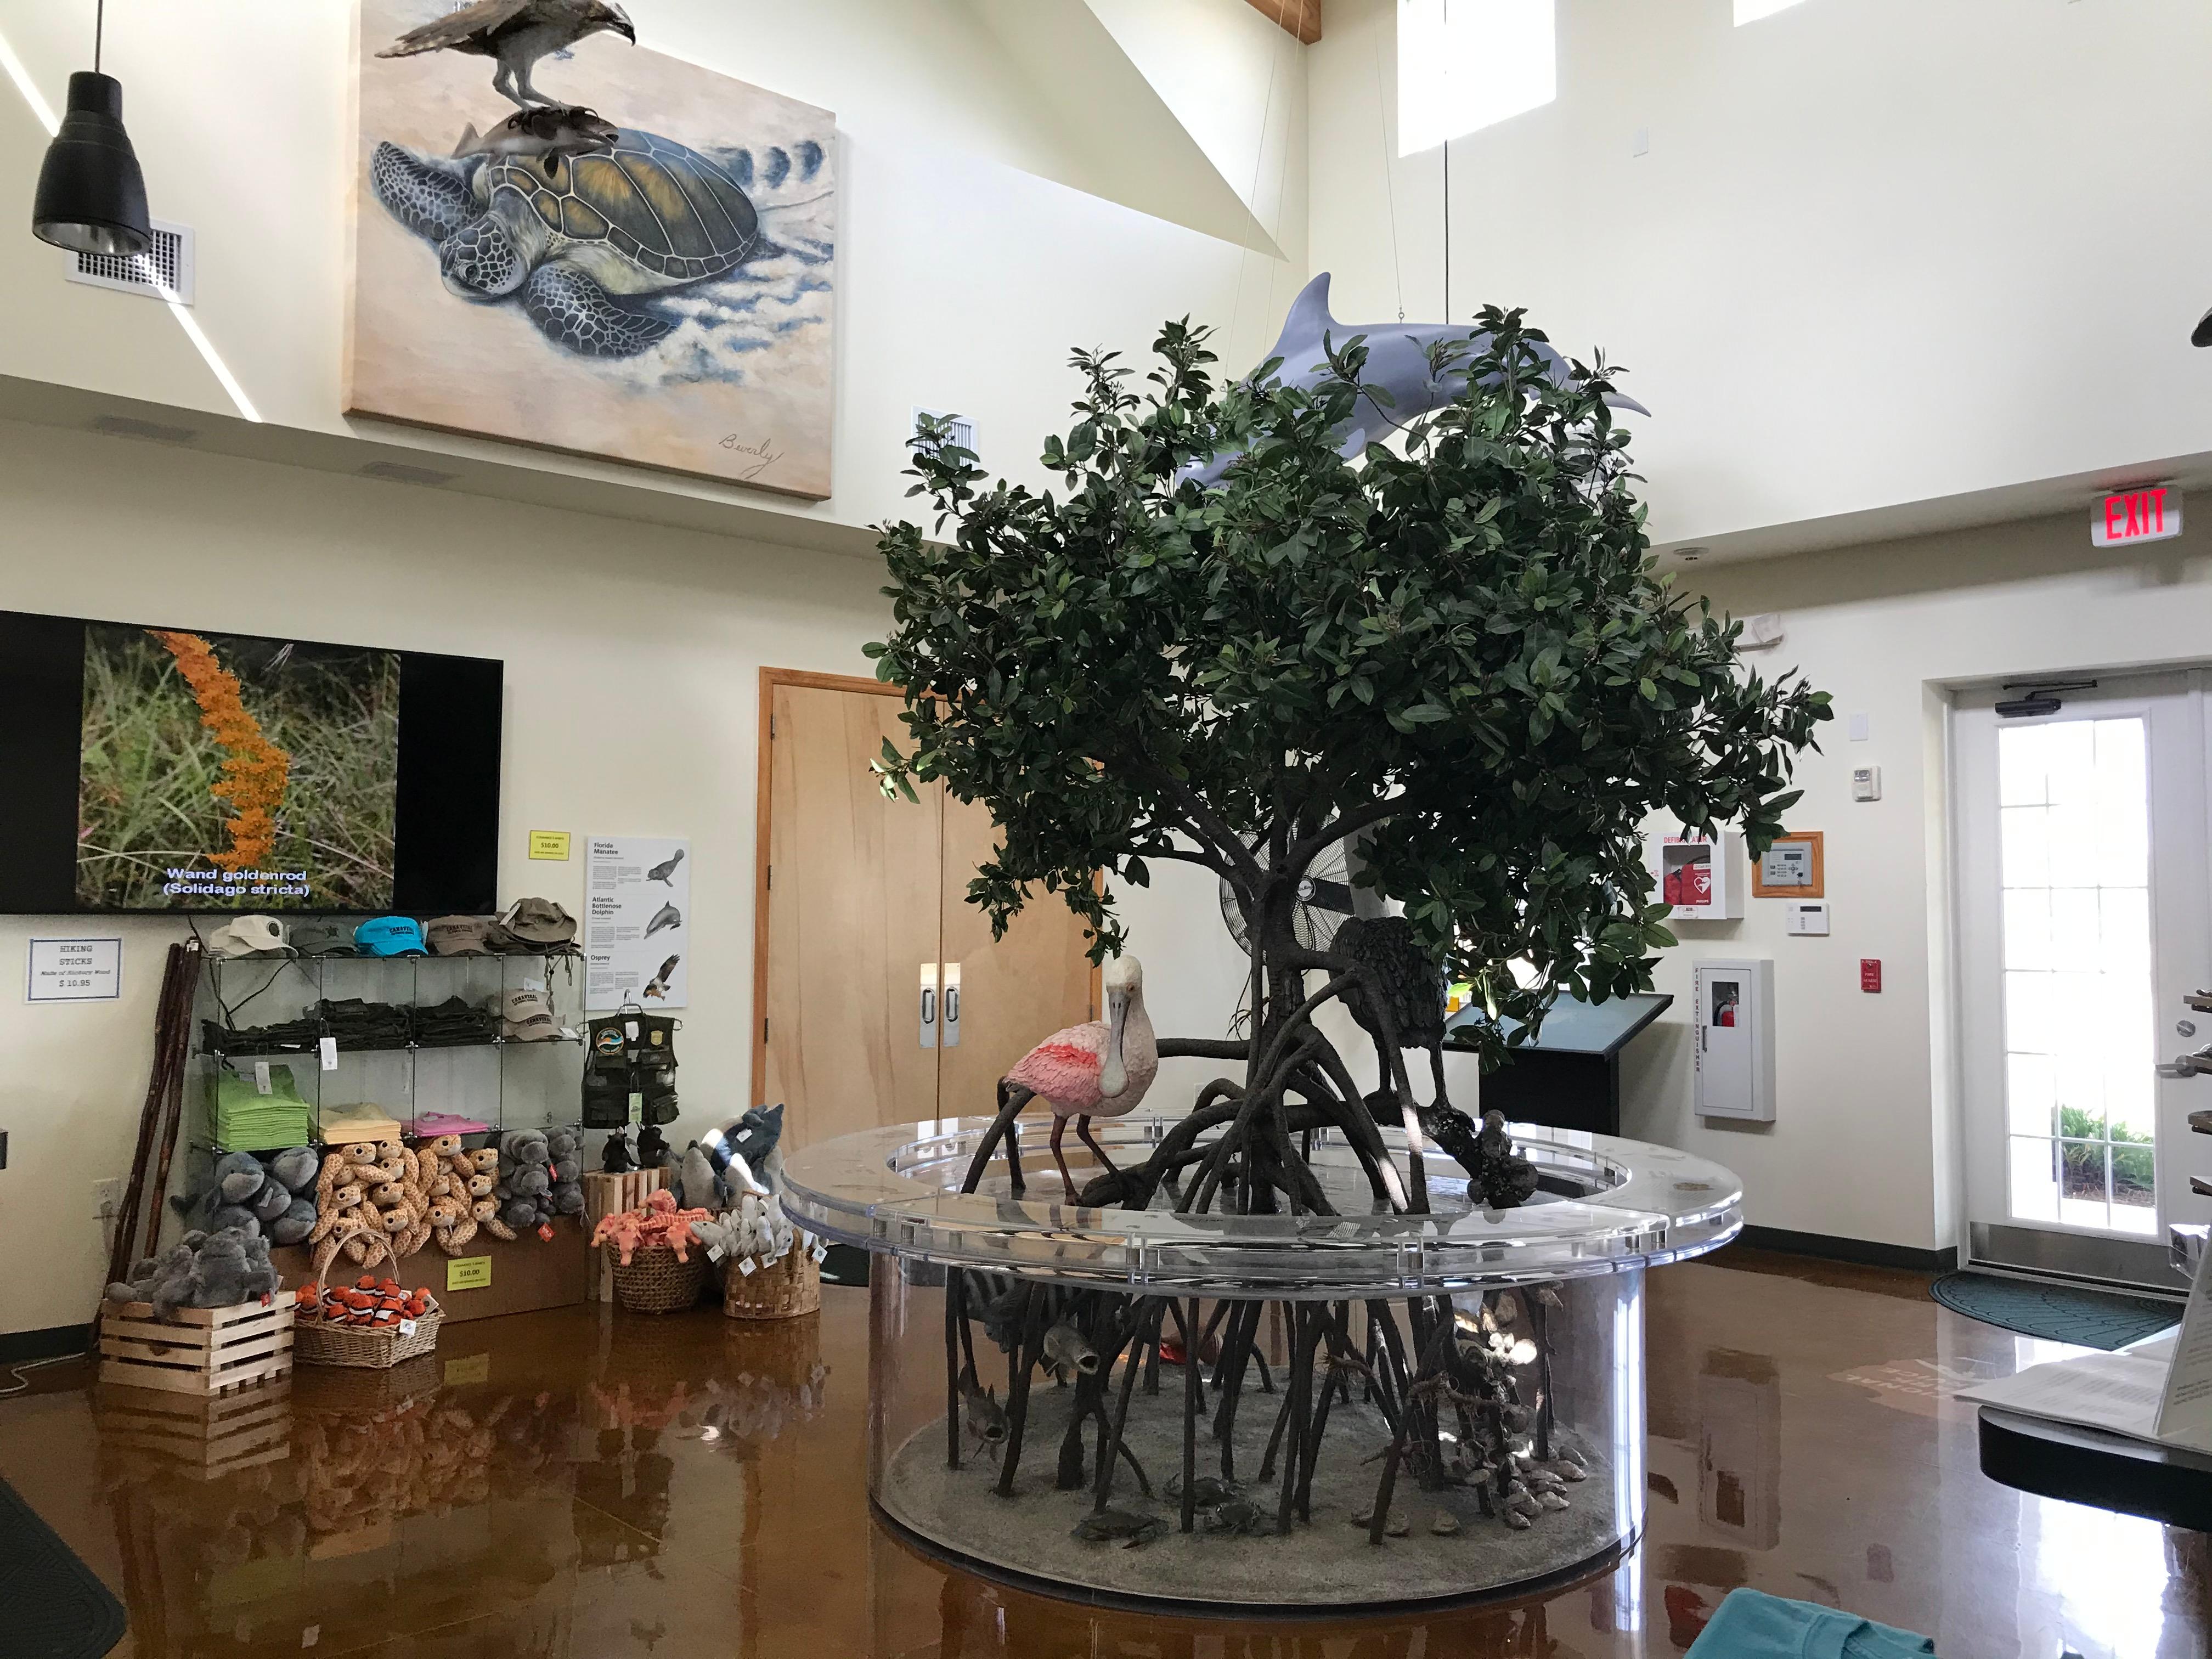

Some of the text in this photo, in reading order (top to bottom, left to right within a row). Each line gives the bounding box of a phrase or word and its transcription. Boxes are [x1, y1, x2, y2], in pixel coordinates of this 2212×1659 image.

[718, 433, 785, 481] Beverly
[2104, 488, 2167, 540] EXIT
[167, 868, 307, 882] Wand goldenrod
[163, 882, 310, 898] (Solidago stricta)
[511, 994, 538, 1003] CANAVERAL
[459, 1269, 480, 1277] $10.00
